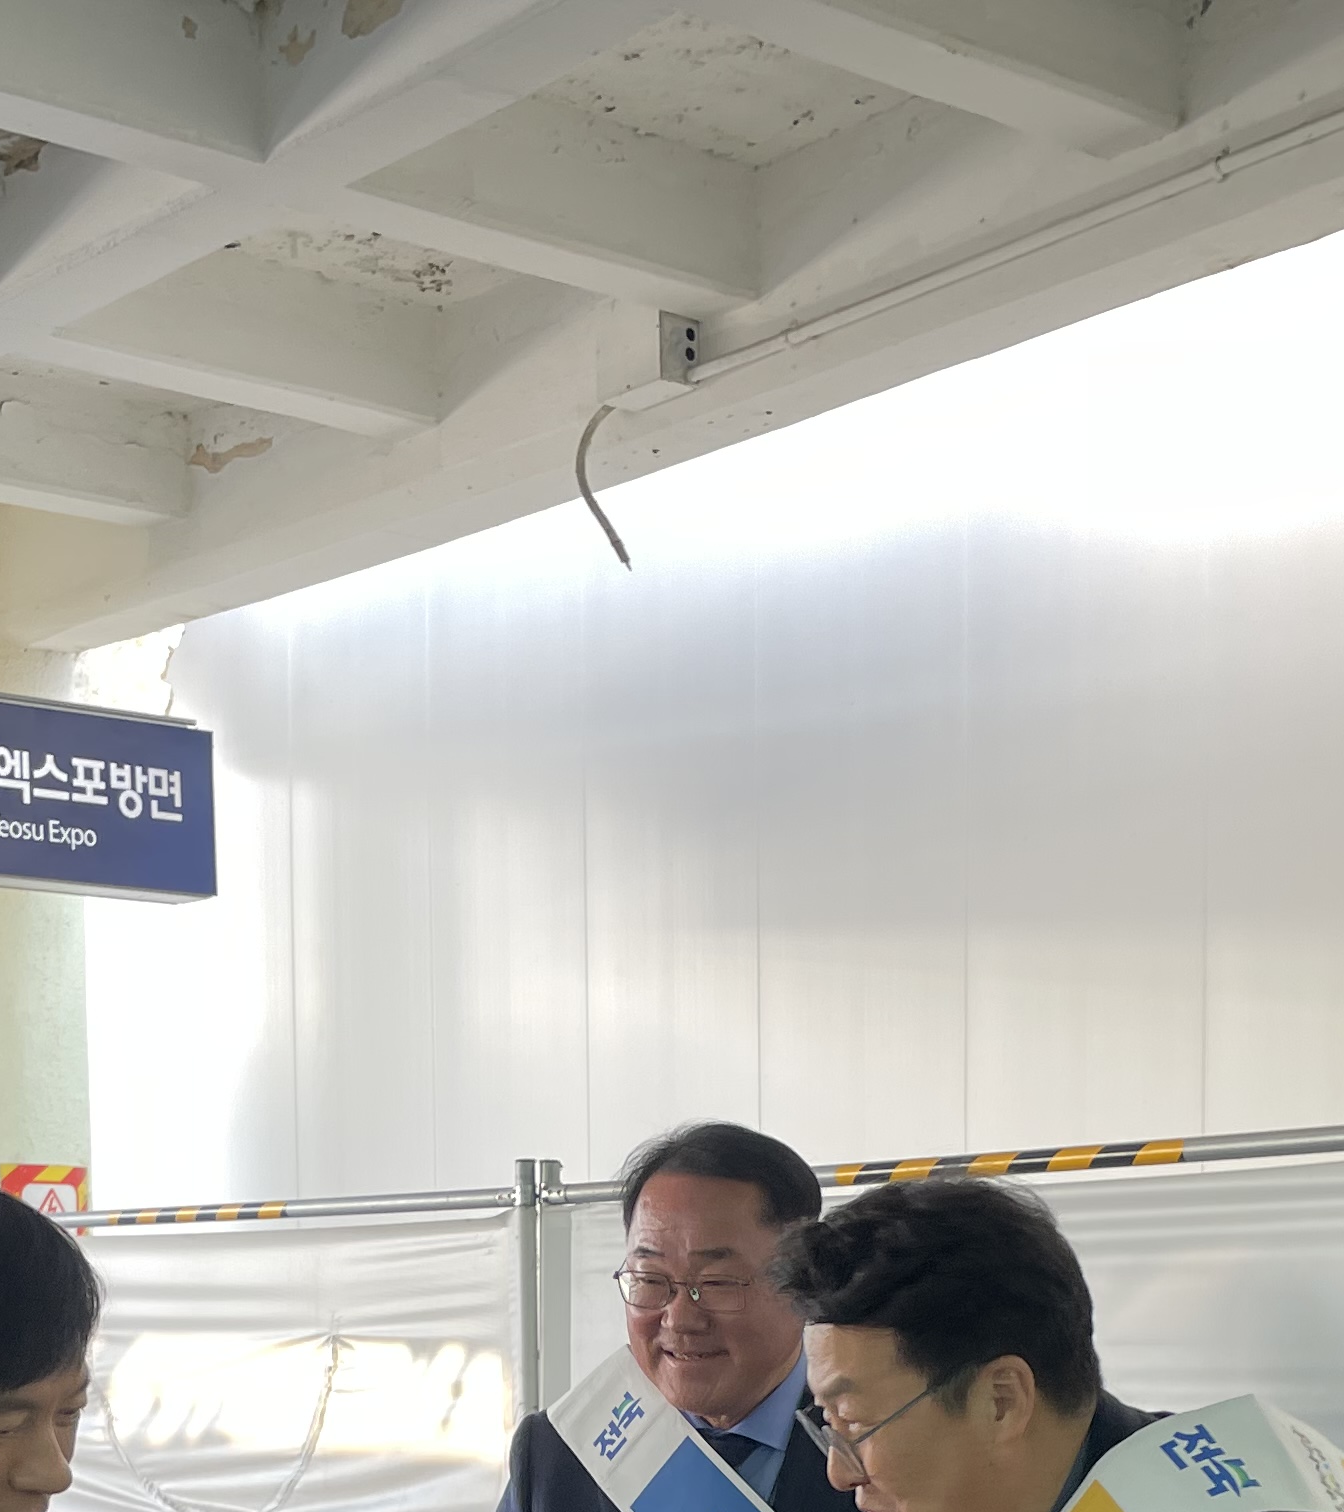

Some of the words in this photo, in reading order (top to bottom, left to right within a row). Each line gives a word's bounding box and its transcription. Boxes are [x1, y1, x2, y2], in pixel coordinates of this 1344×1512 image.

[48, 818, 98, 850] Expo
[593, 1391, 642, 1461] 전북
[1159, 1423, 1262, 1498] 전북
